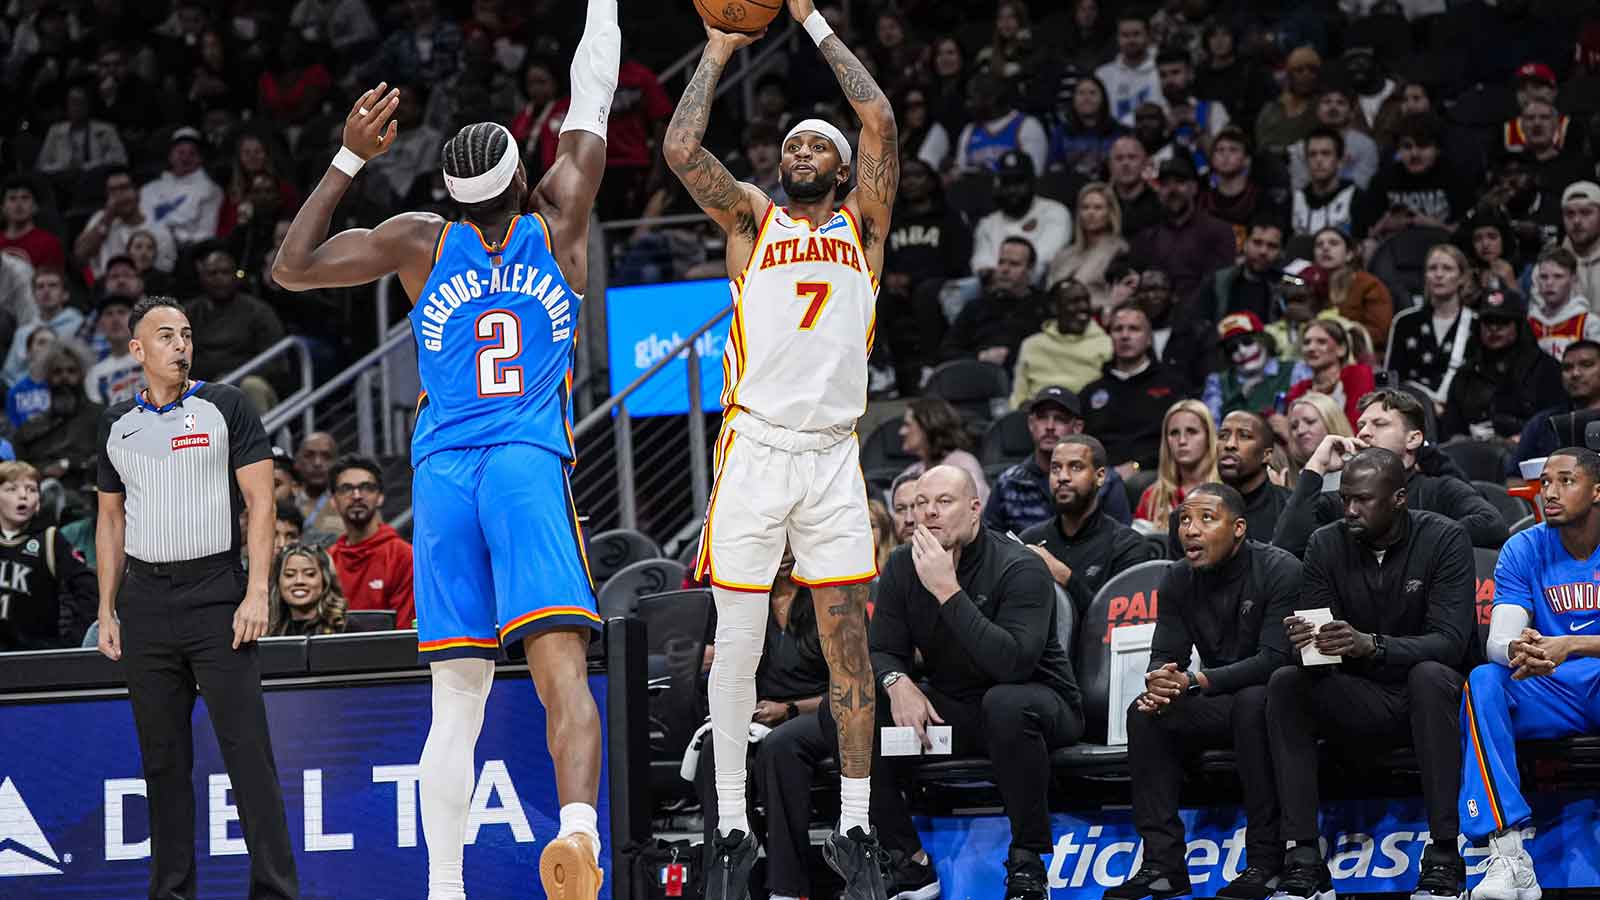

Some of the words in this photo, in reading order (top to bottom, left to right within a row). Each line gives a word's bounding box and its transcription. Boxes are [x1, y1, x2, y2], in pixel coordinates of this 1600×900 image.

[760, 237, 862, 272] ATLANTA
[421, 263, 570, 352] GILGEOUS-ALEXANDER
[796, 282, 831, 331] 7
[475, 309, 523, 398] 2
[172, 436, 209, 448] Emirates
[1547, 582, 1600, 614] HUND
[104, 760, 536, 860] DELTA
